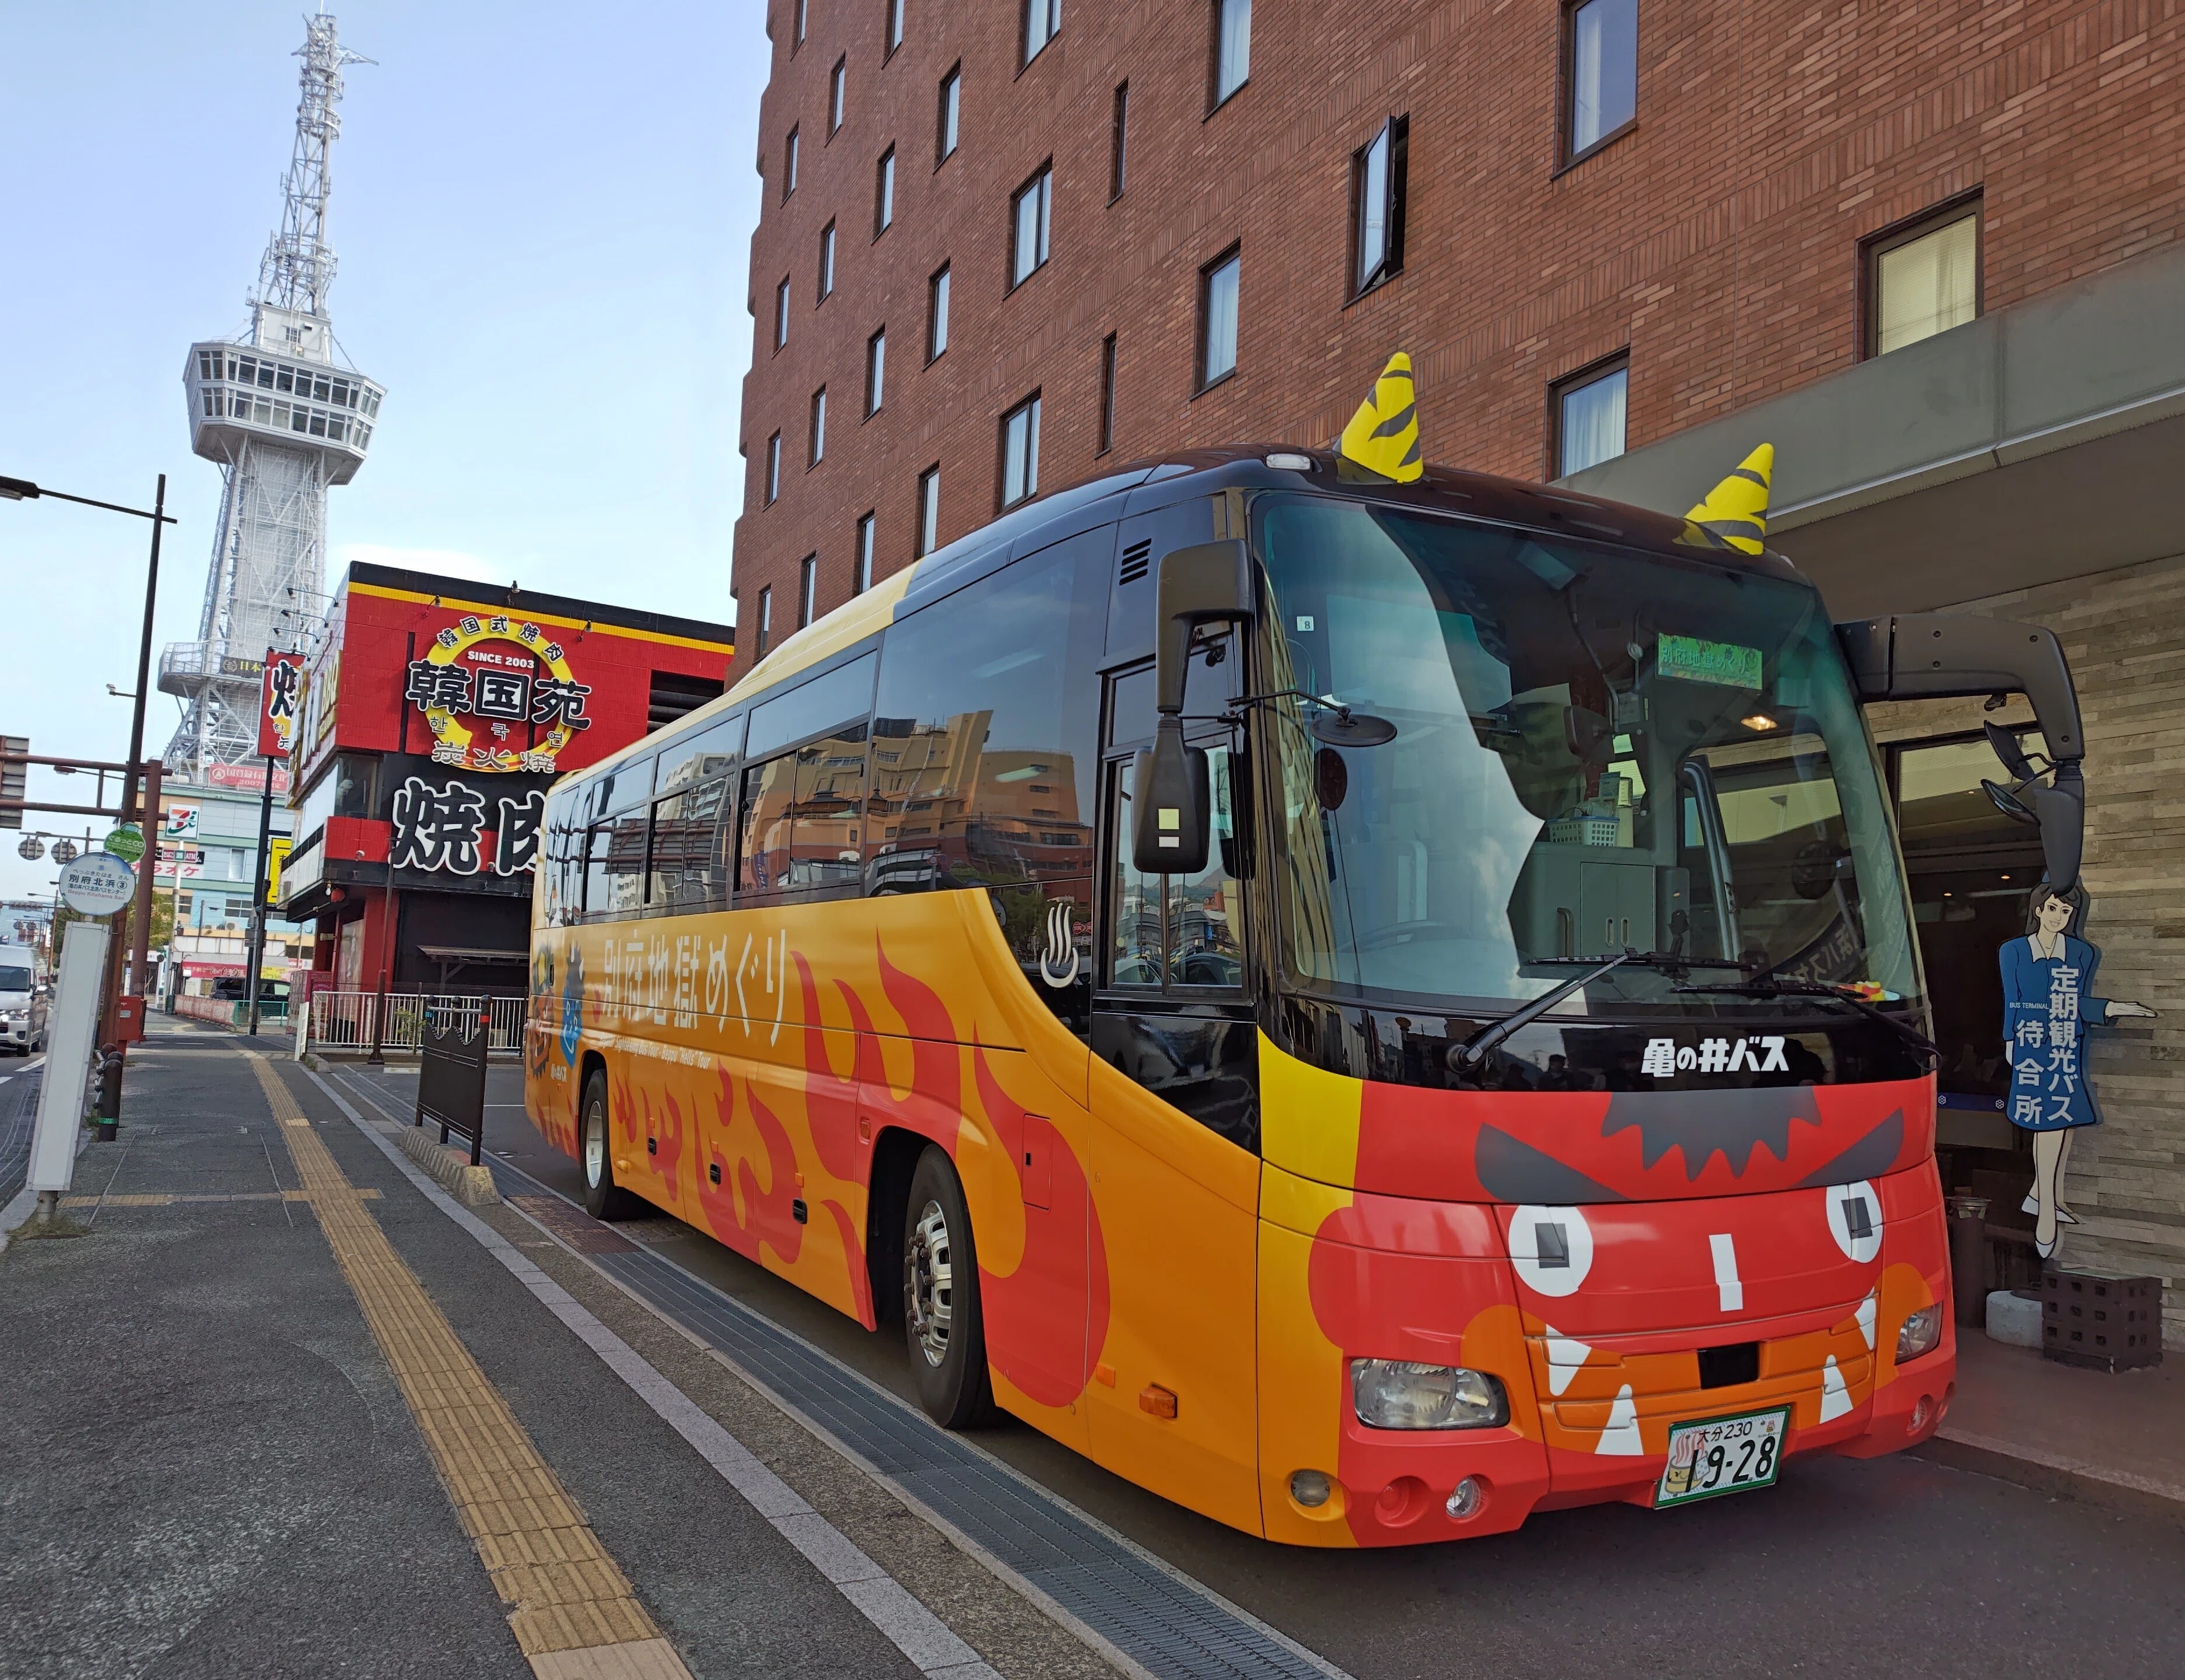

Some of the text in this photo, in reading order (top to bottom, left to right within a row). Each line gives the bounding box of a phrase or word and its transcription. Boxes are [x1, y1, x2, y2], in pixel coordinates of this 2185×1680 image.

[437, 616, 564, 663] 韓国式焼肉
[1305, 621, 1310, 629] 8
[467, 651, 534, 669] SINCE 2003
[1662, 645, 1746, 674] 別府地獄めぐり
[405, 659, 591, 730] 韓国苑
[432, 741, 556, 774] 炭火焼
[72, 869, 112, 879] べっぷきたはま
[603, 929, 786, 1047] 別府地獄めぐり
[648, 1043, 659, 1058] Tour
[661, 1044, 677, 1065] Beppu
[697, 1050, 711, 1069] Tour
[1641, 1036, 1789, 1077] 亀の井バス
[2047, 964, 2079, 1123] 定期観光バス
[2014, 1019, 2044, 1124] 待合所
